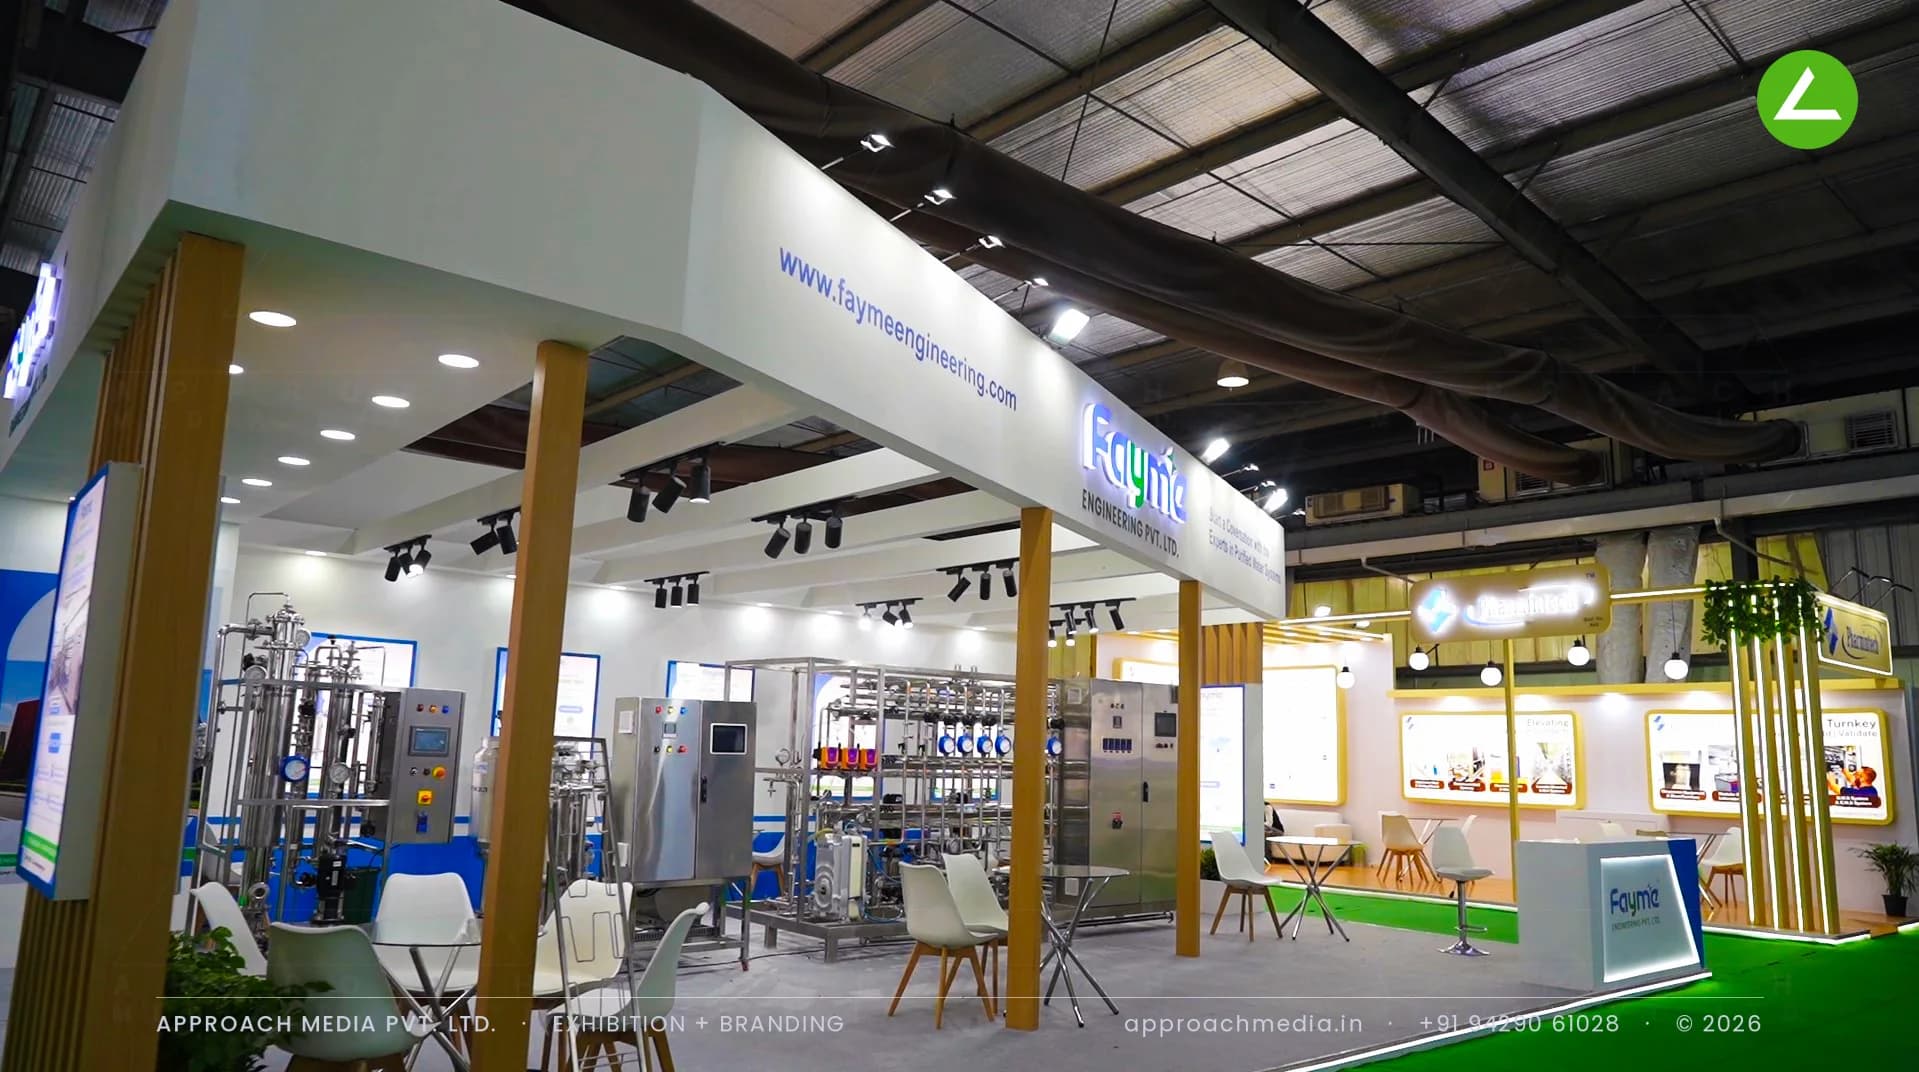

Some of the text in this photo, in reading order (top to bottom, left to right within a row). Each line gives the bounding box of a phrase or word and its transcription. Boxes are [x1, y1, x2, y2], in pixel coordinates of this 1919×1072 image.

[779, 246, 1018, 412] www.faymeengineering.com
[1083, 403, 1188, 524] Fayme
[1081, 488, 1181, 558] ENGINEERING PVT. LTD.
[1527, 718, 1570, 729] Elevating
[1827, 719, 1877, 729] Turnkey
[1838, 729, 1878, 738] Validate
[1610, 887, 1660, 917] Fayme
